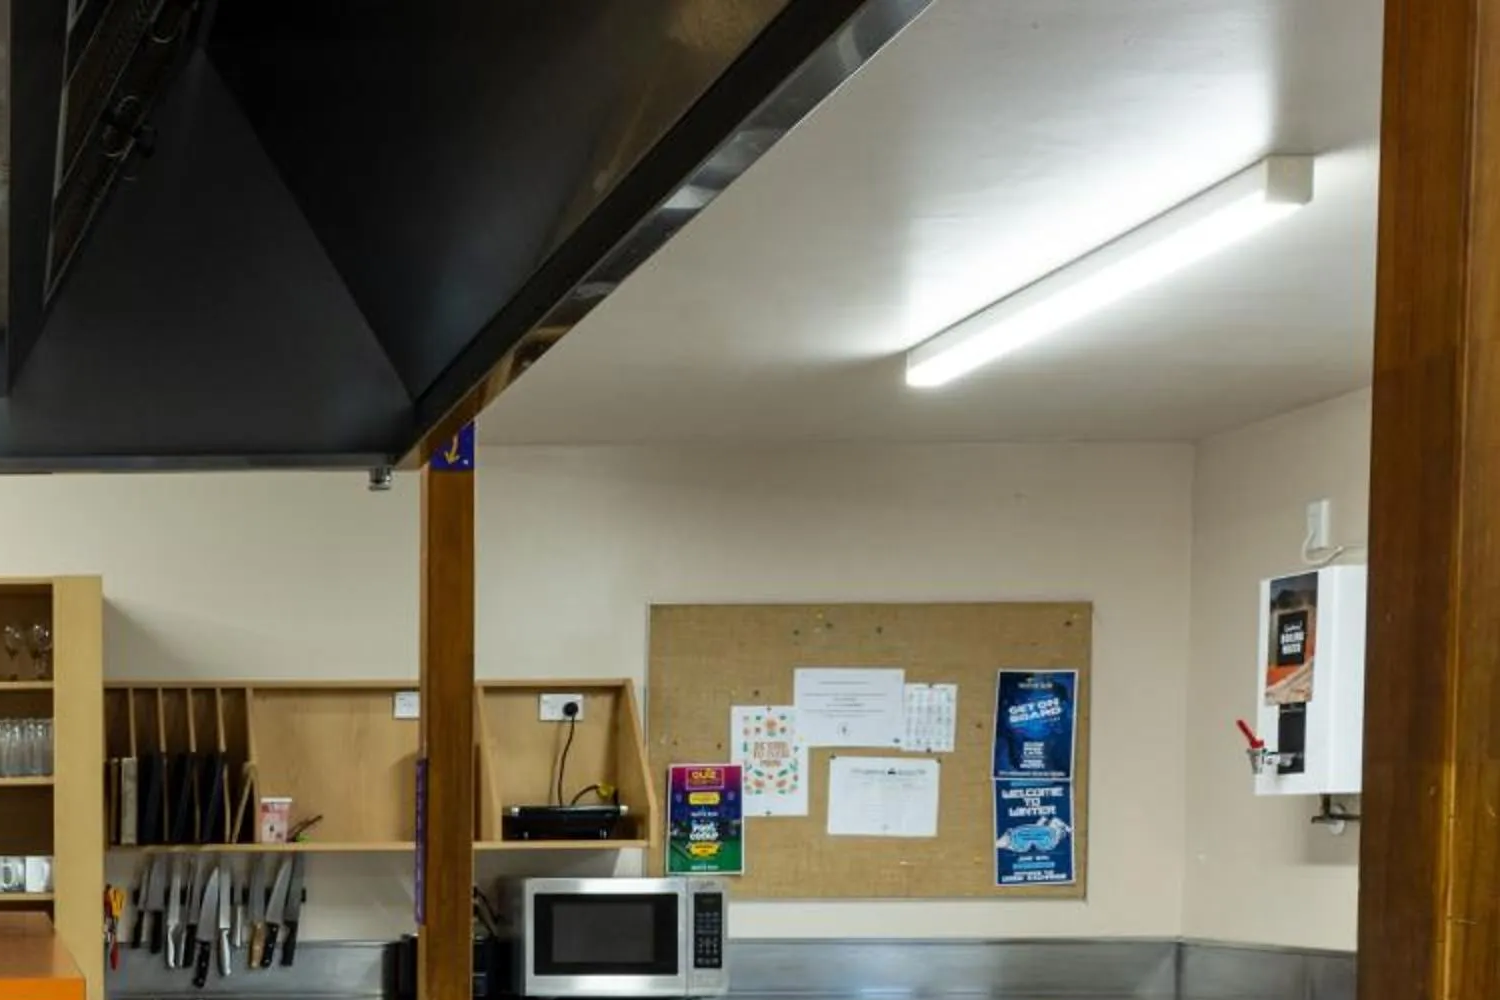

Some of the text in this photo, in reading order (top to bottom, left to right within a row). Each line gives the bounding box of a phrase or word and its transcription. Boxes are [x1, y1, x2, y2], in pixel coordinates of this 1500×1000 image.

[1008, 697, 1060, 715] GET ON
[1001, 786, 1064, 799] WELCOME
[1024, 797, 1041, 807] TO
[1008, 805, 1057, 817] WINTER
